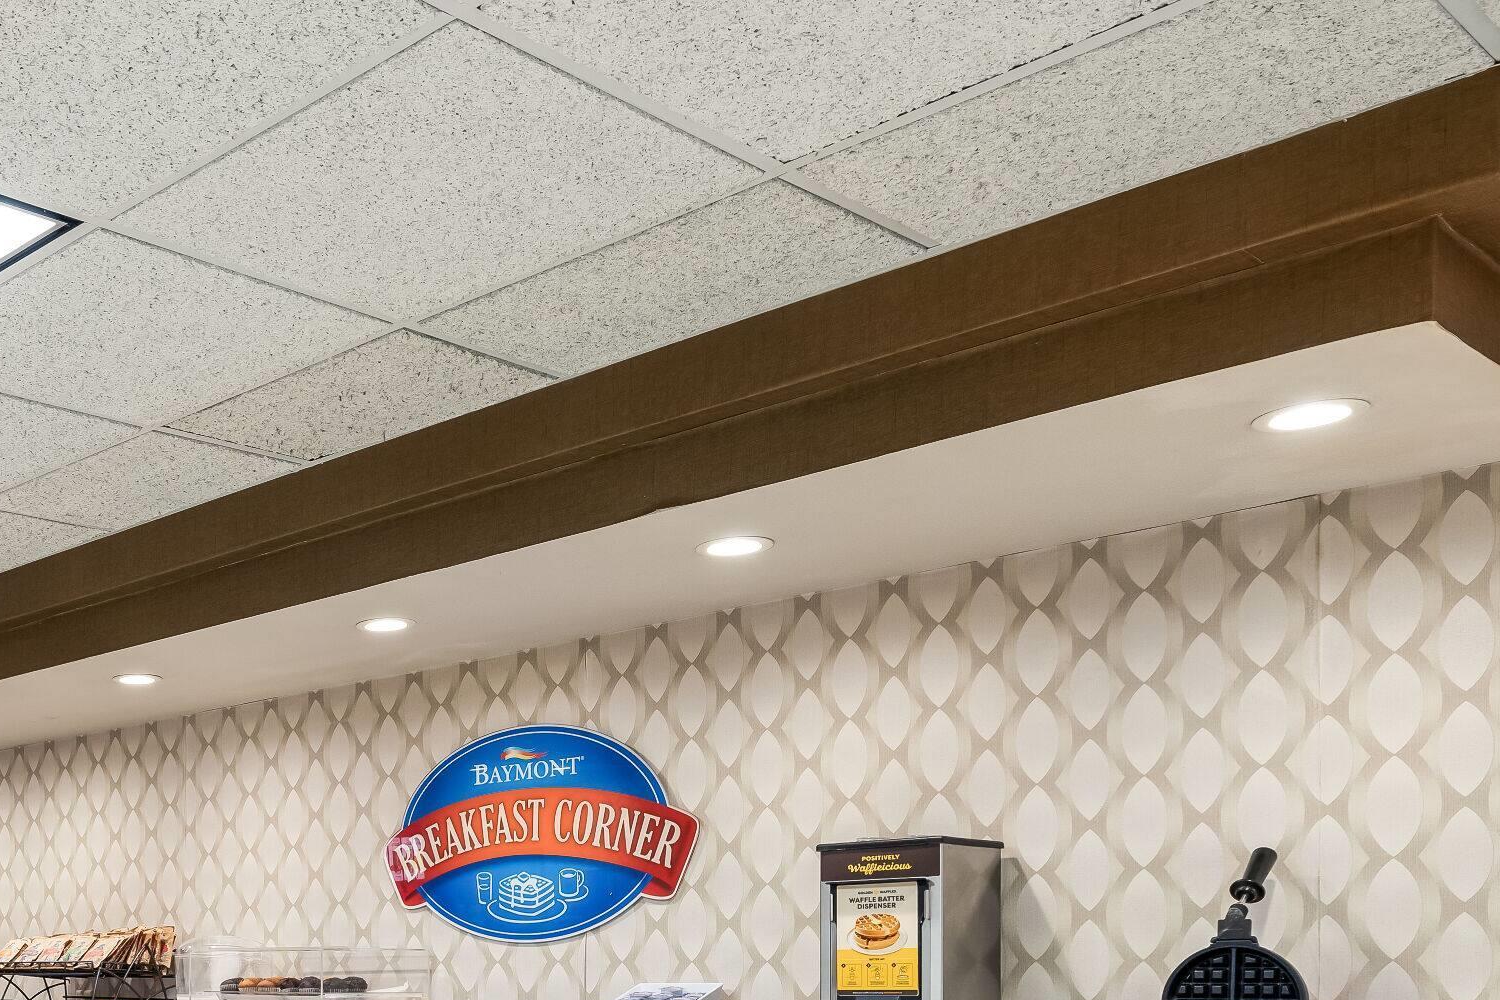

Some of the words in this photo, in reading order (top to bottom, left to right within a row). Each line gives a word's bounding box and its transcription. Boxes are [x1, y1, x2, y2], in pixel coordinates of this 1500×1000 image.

[470, 755, 581, 786] BAYMONT
[395, 798, 545, 883] BREAKFAST
[553, 798, 682, 869] CORNER
[848, 896, 877, 904] WAFFLE
